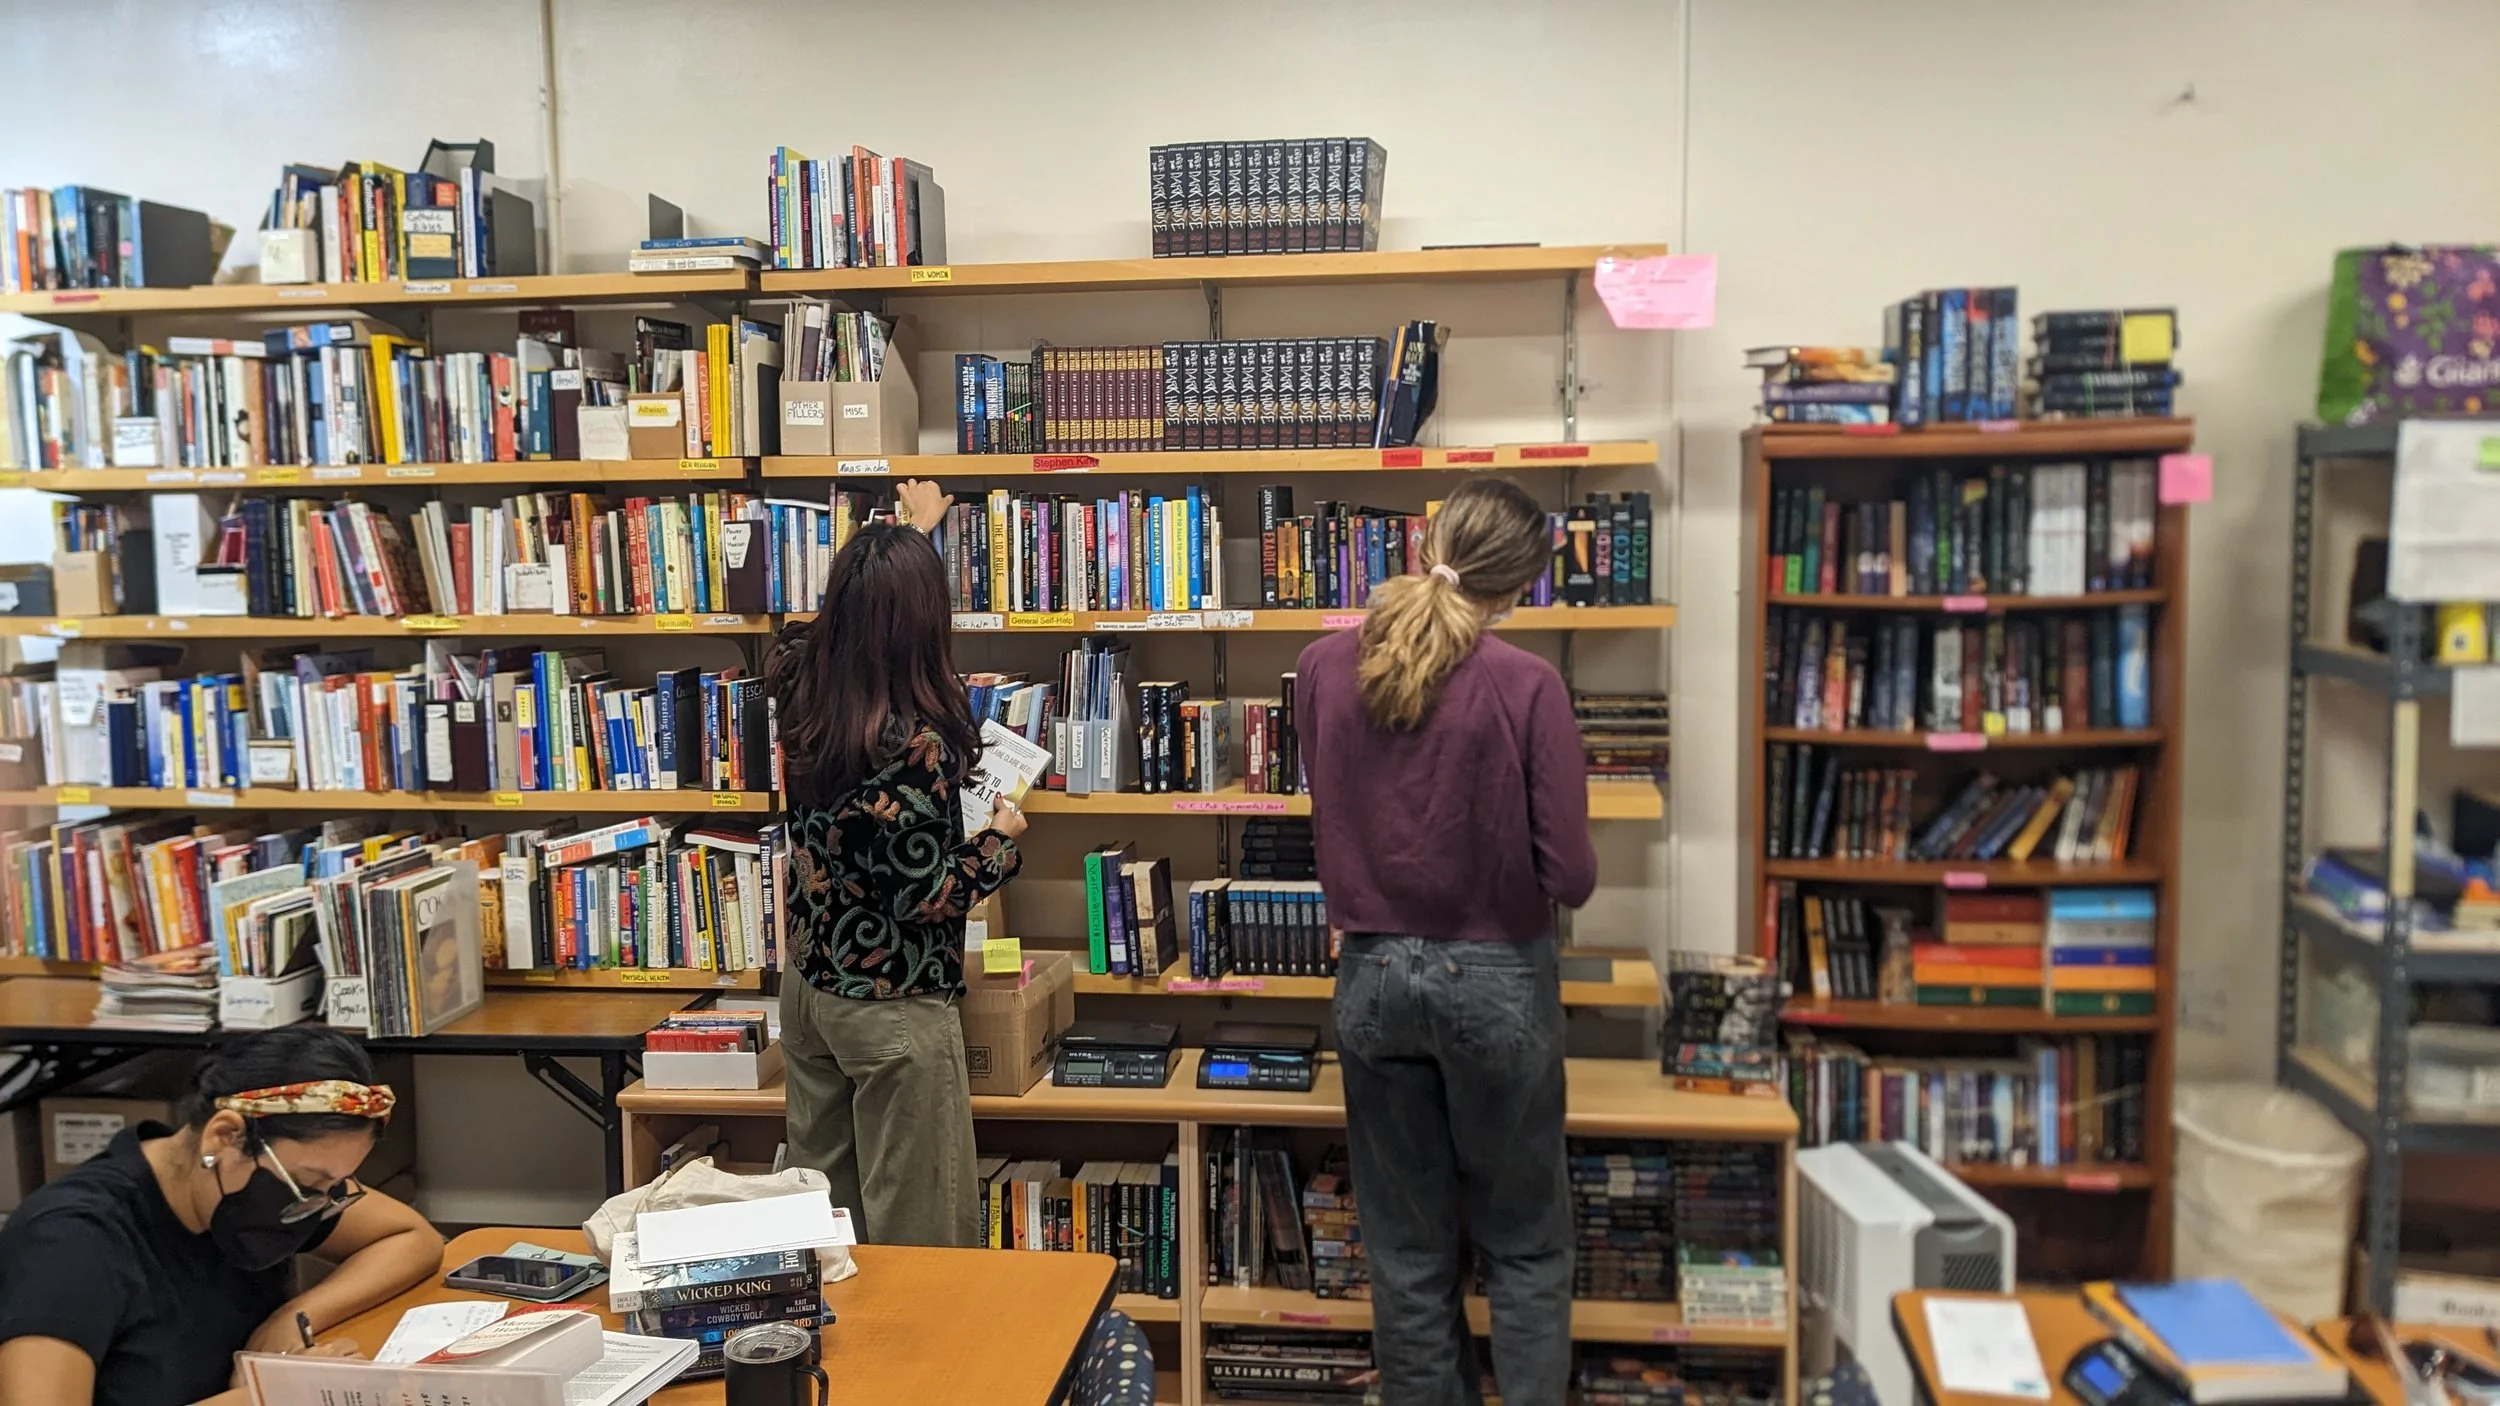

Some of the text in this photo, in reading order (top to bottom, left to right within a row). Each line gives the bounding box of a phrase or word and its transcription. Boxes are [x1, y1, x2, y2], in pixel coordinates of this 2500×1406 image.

[1152, 174, 1167, 233] DARK HOUSE
[1170, 172, 1185, 231] DARK HOUSE
[1188, 171, 1203, 230] DARK HOUSE
[1207, 170, 1223, 230] DARK HOUSE
[1227, 170, 1242, 230] DARK HOUSE
[1247, 169, 1263, 229] DARK HOUSE
[1266, 168, 1282, 228] DARK HOUSE
[1286, 167, 1303, 228] DARK HOUSE
[1306, 166, 1322, 227] DARK HOUSE
[1326, 165, 1342, 226] DARK HOUSE
[1346, 166, 1363, 226] DARK HOUSE
[913, 270, 949, 280] FOR WOMEN
[638, 404, 668, 414] Atheism
[699, 364, 711, 441] GOD ONE
[792, 401, 819, 410] OTHER
[986, 378, 998, 403] STEPHEN
[1165, 369, 1180, 425] DARK HOUSE
[1184, 369, 1199, 425] DARK HOUSE
[1203, 369, 1218, 425] DARK HOUSE
[1222, 368, 1237, 424] DARK HOUSE
[1241, 368, 1256, 424] DARK HOUSE
[1260, 367, 1275, 423] DARK HOUSE
[1279, 367, 1294, 423] DARK HOUSE
[1299, 365, 1314, 423] DARK HOUSE
[1318, 365, 1333, 423] DARK HOUSE
[1338, 365, 1353, 421] DARK HOUSE
[1357, 365, 1372, 421] DARK HOUSE
[787, 408, 825, 419] FILLERS
[986, 404, 999, 419] KING
[1034, 458, 1074, 471] Stephen
[1085, 509, 1093, 521] Tim
[1176, 519, 1183, 527] TO
[1190, 517, 1198, 537] Search
[1263, 490, 1276, 577] JON EVANS EXADELIC
[994, 523, 1004, 577] THE 10X RULE
[1177, 542, 1183, 550] TO
[1040, 562, 1048, 593] UNIVERSE
[1133, 567, 1142, 581] Life
[1191, 556, 1199, 579] Yourself
[657, 620, 693, 629] Spirituality
[1011, 614, 1073, 626] General Self-Help
[549, 671, 557, 695] Anxiety
[553, 725, 561, 755] Workbook
[703, 692, 710, 701] My
[1142, 688, 1150, 725] HALO
[1160, 687, 1168, 724] HALO
[573, 714, 579, 724] ON
[660, 690, 672, 759] Creating Minds
[1003, 752, 1020, 768] CLAIRE
[991, 776, 1002, 788] TO
[695, 874, 704, 895] Managing
[760, 845, 774, 914] Fitness & Health
[1088, 862, 1100, 931] NIGHT WITCH
[622, 974, 649, 982] PHYSICAL
[1121, 1186, 1129, 1208] MARGARET
[1161, 1187, 1171, 1278] MARGARET ATWOOD
[616, 1294, 639, 1303] HOLLY
[676, 1279, 771, 1301] WICKED KING
[785, 1303, 817, 1314] BALLENGER
[706, 1311, 764, 1325] COWBOY WOLF
[719, 1304, 750, 1314] WICKED
[1213, 1366, 1292, 1379] ULTIMATE
